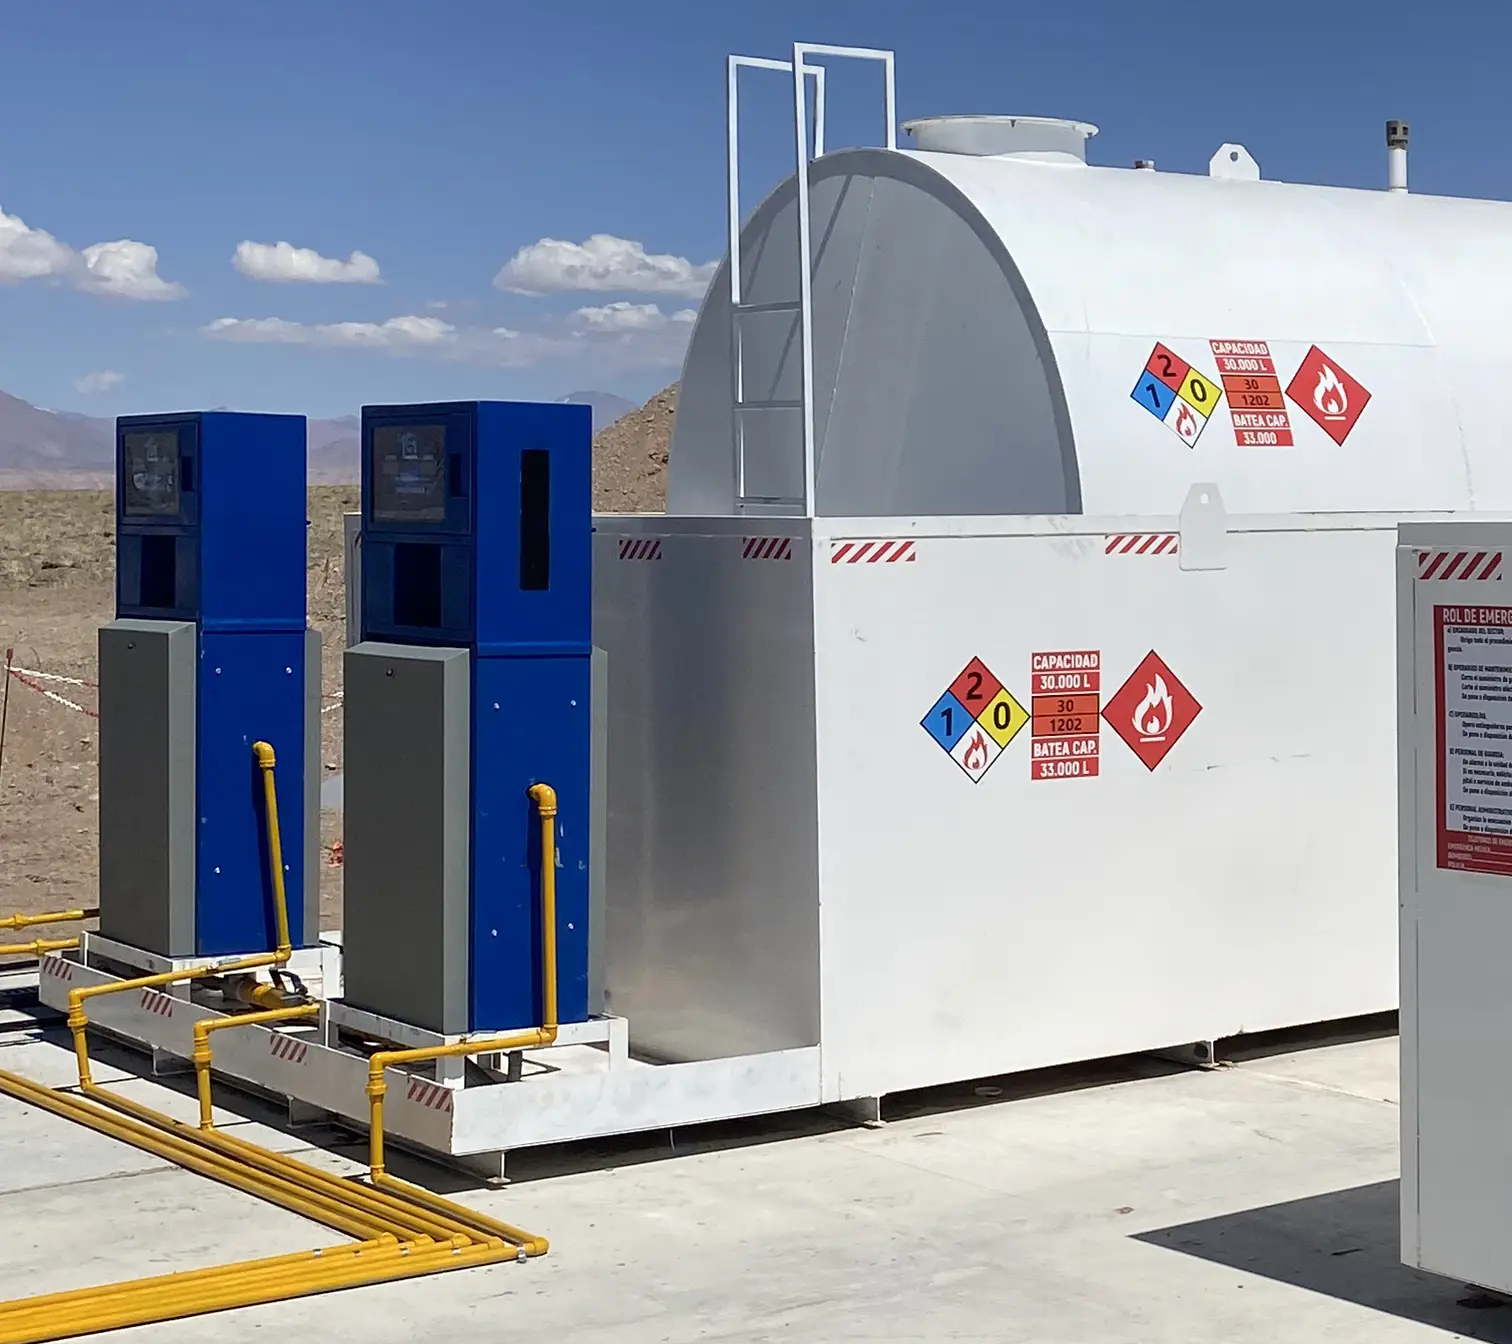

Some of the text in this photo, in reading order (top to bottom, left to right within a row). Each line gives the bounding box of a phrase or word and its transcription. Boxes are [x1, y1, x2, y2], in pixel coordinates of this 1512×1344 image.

[1212, 341, 1268, 355] CAPACIDAD
[1157, 355, 1177, 377] 2
[1224, 359, 1267, 371] 30.000 L
[1244, 380, 1259, 390] 30
[1146, 379, 1207, 408] 1 0
[1242, 395, 1269, 406] 1202
[1234, 413, 1288, 428] BATEA CAP.
[1243, 432, 1276, 444] 33.000
[1443, 608, 1462, 622] ROL
[1464, 609, 1477, 623] DE
[1033, 653, 1098, 670] CAPACIDAD
[966, 672, 983, 700] 2
[1040, 674, 1090, 690] 30.000 L
[1057, 699, 1074, 713] 30
[941, 701, 1010, 736] 1 0
[1050, 718, 1082, 732] 1202
[1033, 739, 1097, 758] BATEA CAP.
[1040, 760, 1089, 777] 33.000 L
